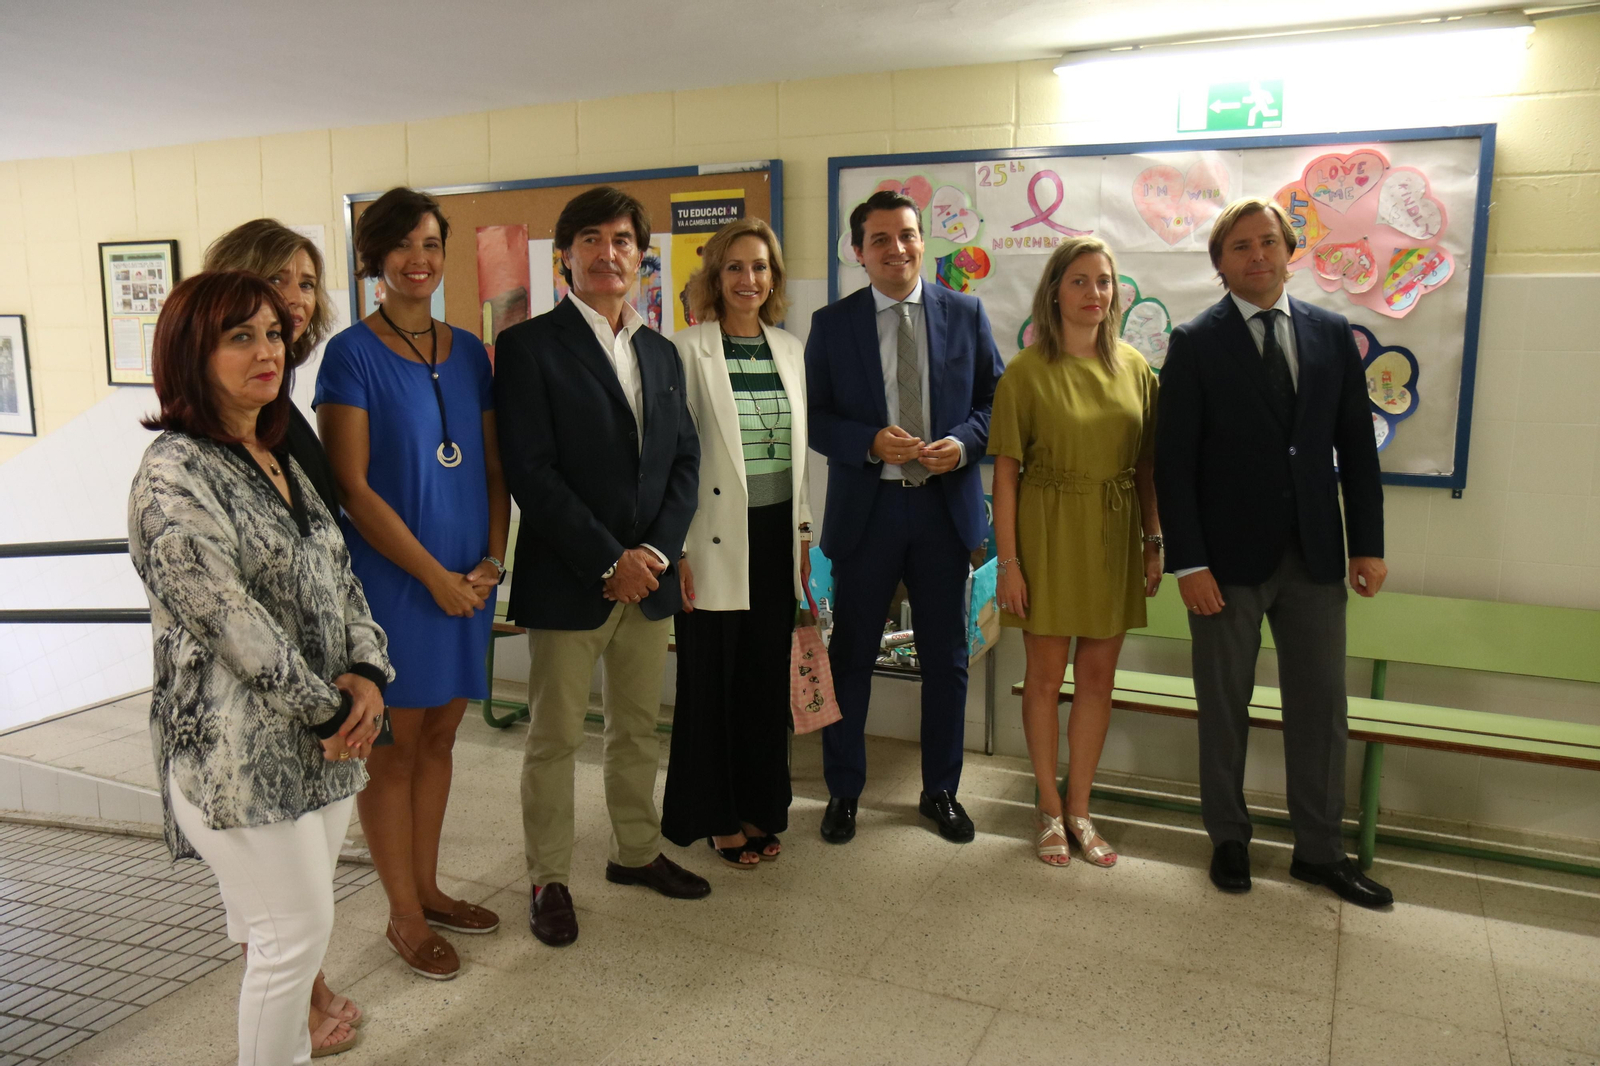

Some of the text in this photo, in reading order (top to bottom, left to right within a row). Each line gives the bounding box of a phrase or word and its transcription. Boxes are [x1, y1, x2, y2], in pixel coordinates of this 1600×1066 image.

[977, 161, 1025, 187] 25th
[1317, 161, 1367, 184] LOVE
[1143, 183, 1221, 200] I'M WITH
[1328, 187, 1355, 202] ME
[678, 209, 689, 218] TU
[1398, 183, 1435, 238] KINDLY
[689, 219, 711, 227] CAMBIAR
[1161, 216, 1194, 229] YOU
